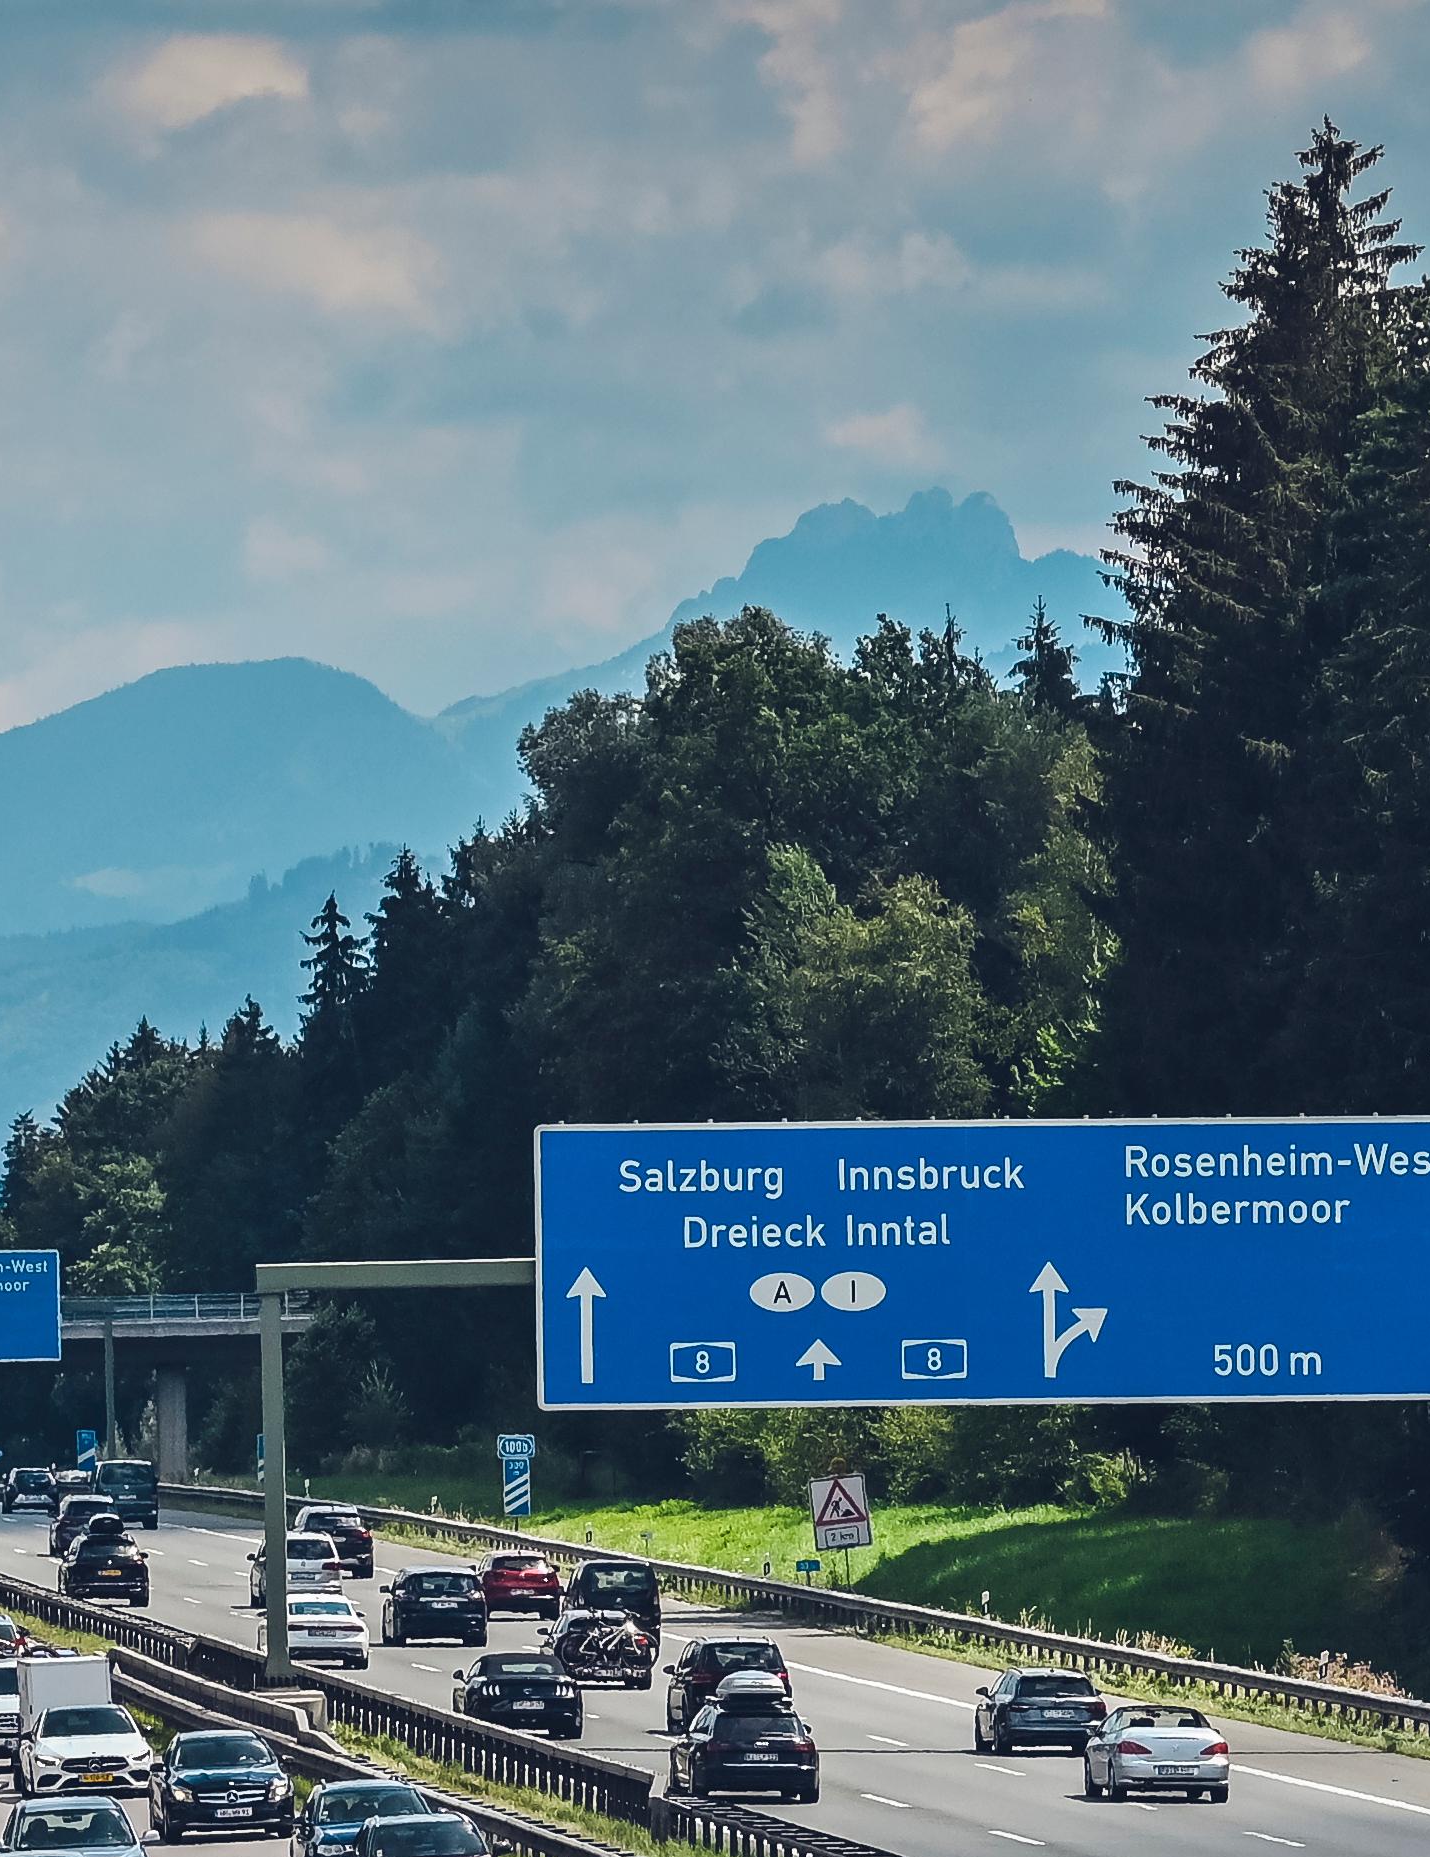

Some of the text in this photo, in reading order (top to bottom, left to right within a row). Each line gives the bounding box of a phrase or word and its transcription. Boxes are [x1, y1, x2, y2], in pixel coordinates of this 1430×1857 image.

[618, 1157, 1025, 1200] Salzburg Innsbruck
[1124, 1192, 1351, 1226] Kolbermoor
[683, 1213, 951, 1248] Dreieck Inntal
[773, 1280, 792, 1305] A
[850, 1279, 856, 1304] I
[694, 1350, 710, 1374] 8
[926, 1347, 942, 1371] 8
[1214, 1343, 1322, 1378] 500 m
